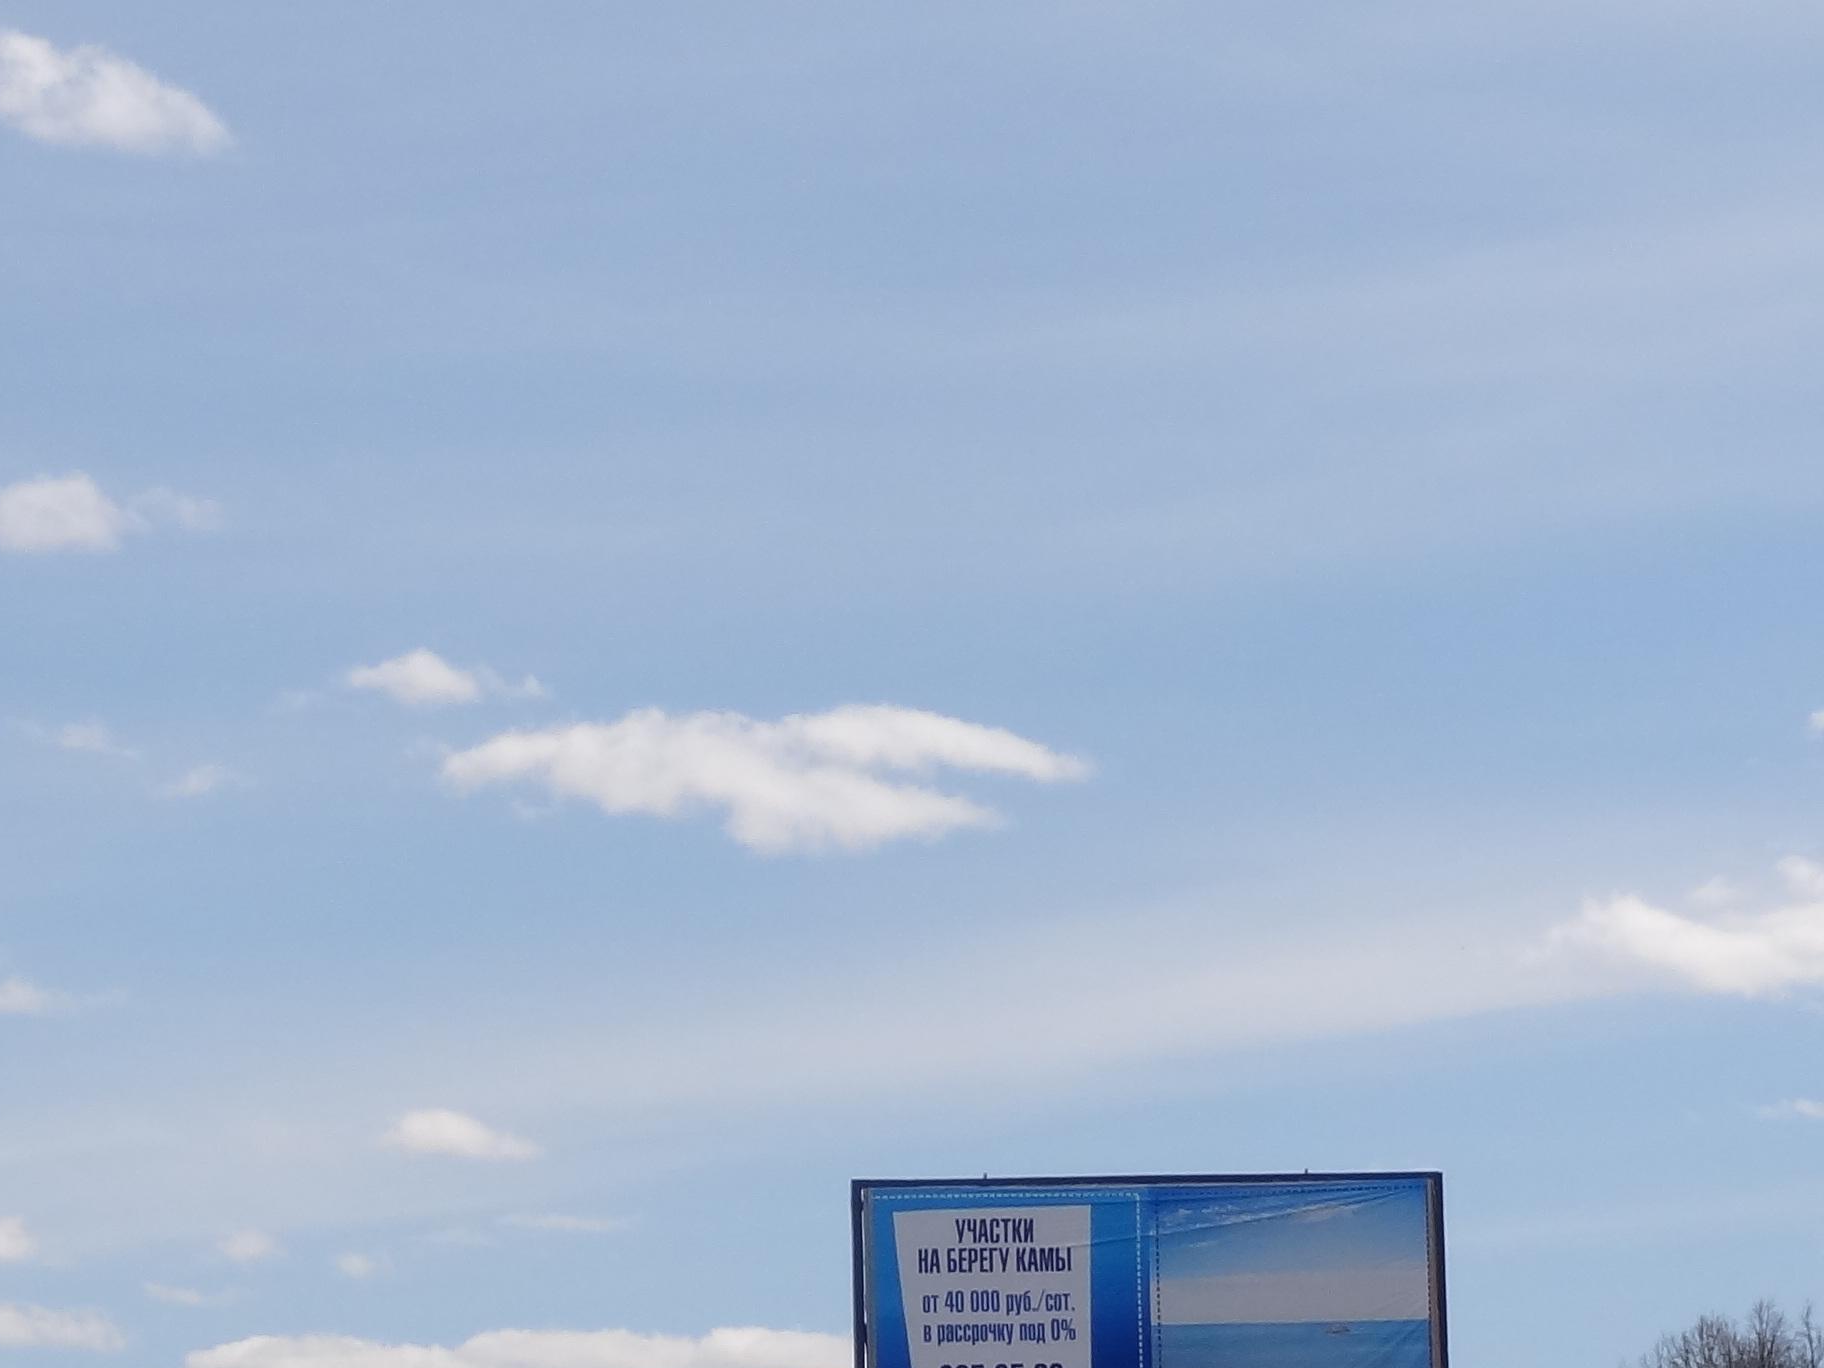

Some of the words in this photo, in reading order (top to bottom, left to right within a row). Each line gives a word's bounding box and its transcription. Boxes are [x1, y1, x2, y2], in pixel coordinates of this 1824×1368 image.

[955, 1218, 1034, 1244] УЧАСТКИ
[918, 1248, 941, 1274] НА
[947, 1247, 1010, 1273] БЕРЕГУ
[1016, 1247, 1072, 1273] КАМЫ
[922, 1295, 939, 1313] от
[944, 1291, 964, 1313] 40
[970, 1290, 1000, 1313] 000
[1005, 1289, 1076, 1316] руб./сот.
[923, 1325, 932, 1343] в
[937, 1322, 1014, 1346] рассрочку
[1019, 1322, 1046, 1344] под
[1051, 1318, 1076, 1341] 0%
